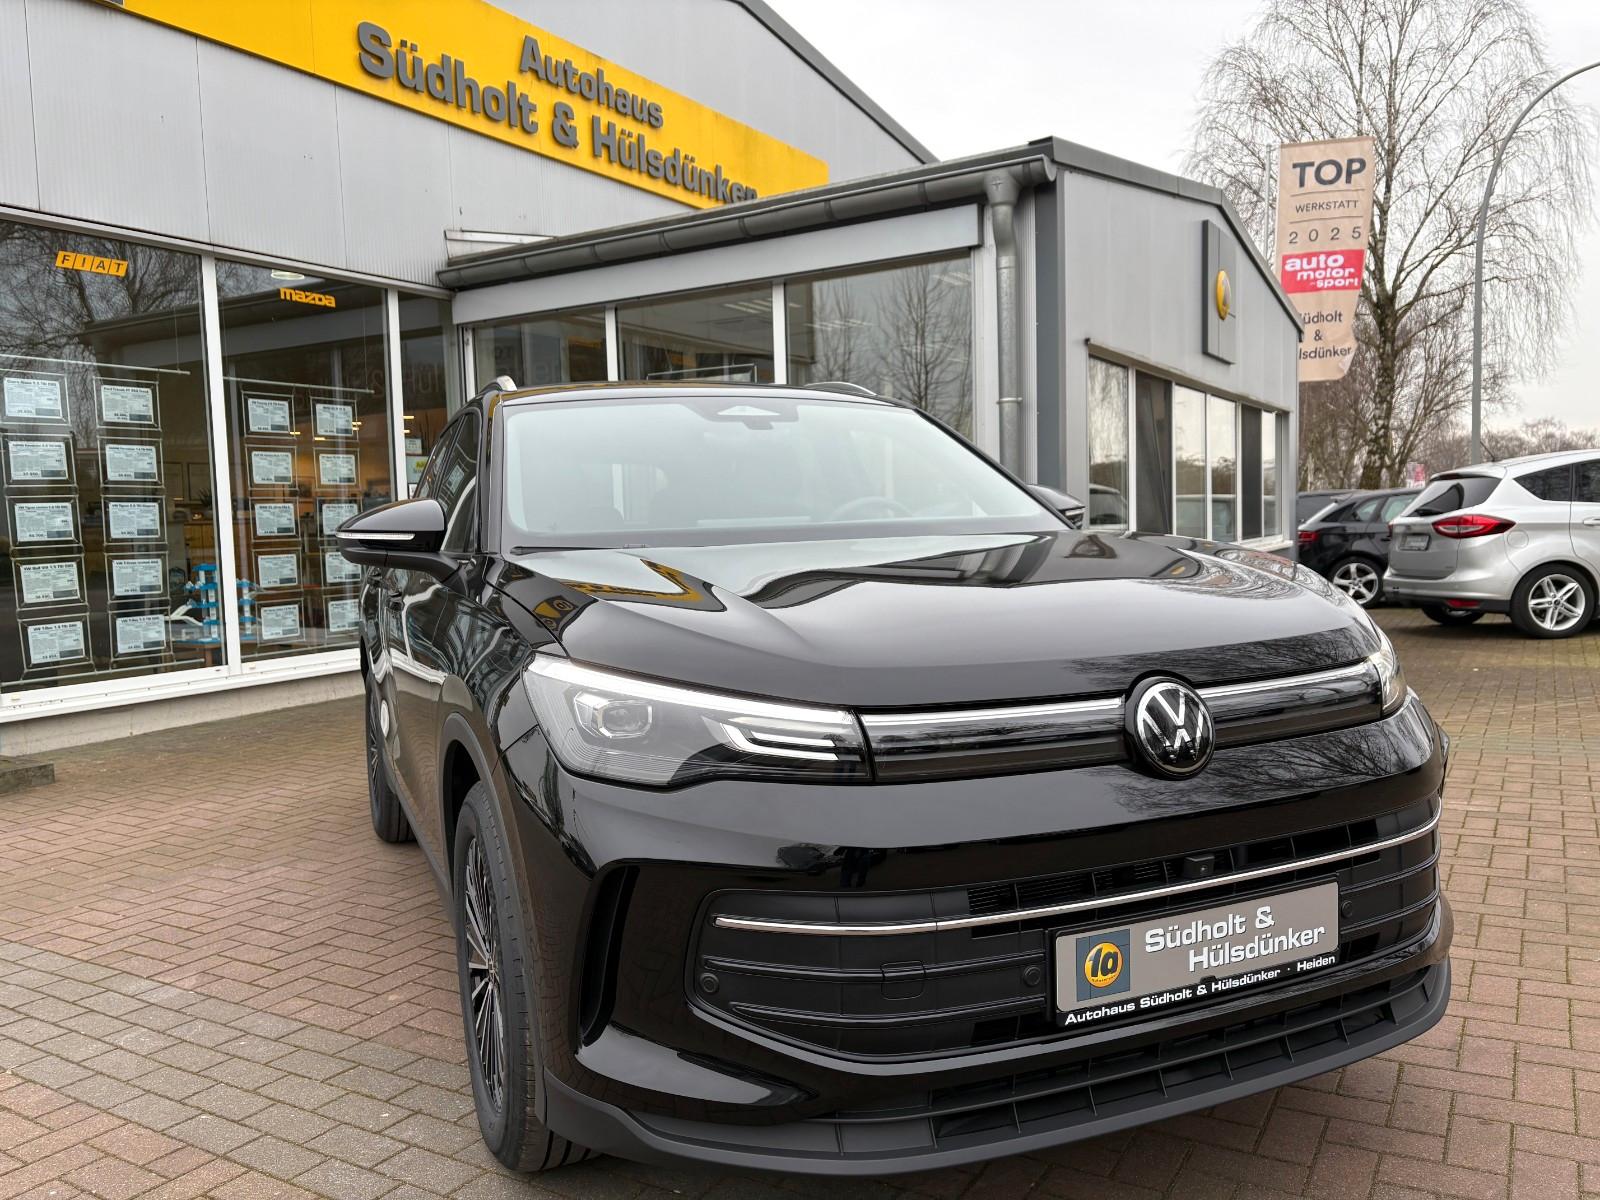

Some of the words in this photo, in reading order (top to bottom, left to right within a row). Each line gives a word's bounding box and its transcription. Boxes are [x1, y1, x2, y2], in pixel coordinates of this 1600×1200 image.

[357, 20, 539, 134] Südholt
[552, 102, 579, 149] &
[519, 34, 665, 129] Autohaus
[1292, 157, 1367, 188] TOP
[1295, 199, 1359, 213] WERKSTATT
[60, 253, 126, 276] FIAT
[1284, 253, 1344, 271] auto
[1296, 267, 1355, 281] motor
[1316, 278, 1359, 288] sport
[280, 287, 336, 309] mazda
[1299, 309, 1343, 325] üdholt
[1314, 329, 1324, 342] &
[1299, 345, 1352, 360] lsdünker
[1145, 912, 1247, 953] Südholt
[1254, 905, 1275, 929] &
[1188, 925, 1326, 973] Hülsdünker
[1088, 946, 1119, 978] 1a
[1064, 1001, 1136, 1025] Autohaus
[1140, 987, 1193, 1008] Südholt
[1196, 984, 1208, 995] &
[1211, 968, 1281, 993] Hülsdünker
[1297, 955, 1336, 973] Heiden
